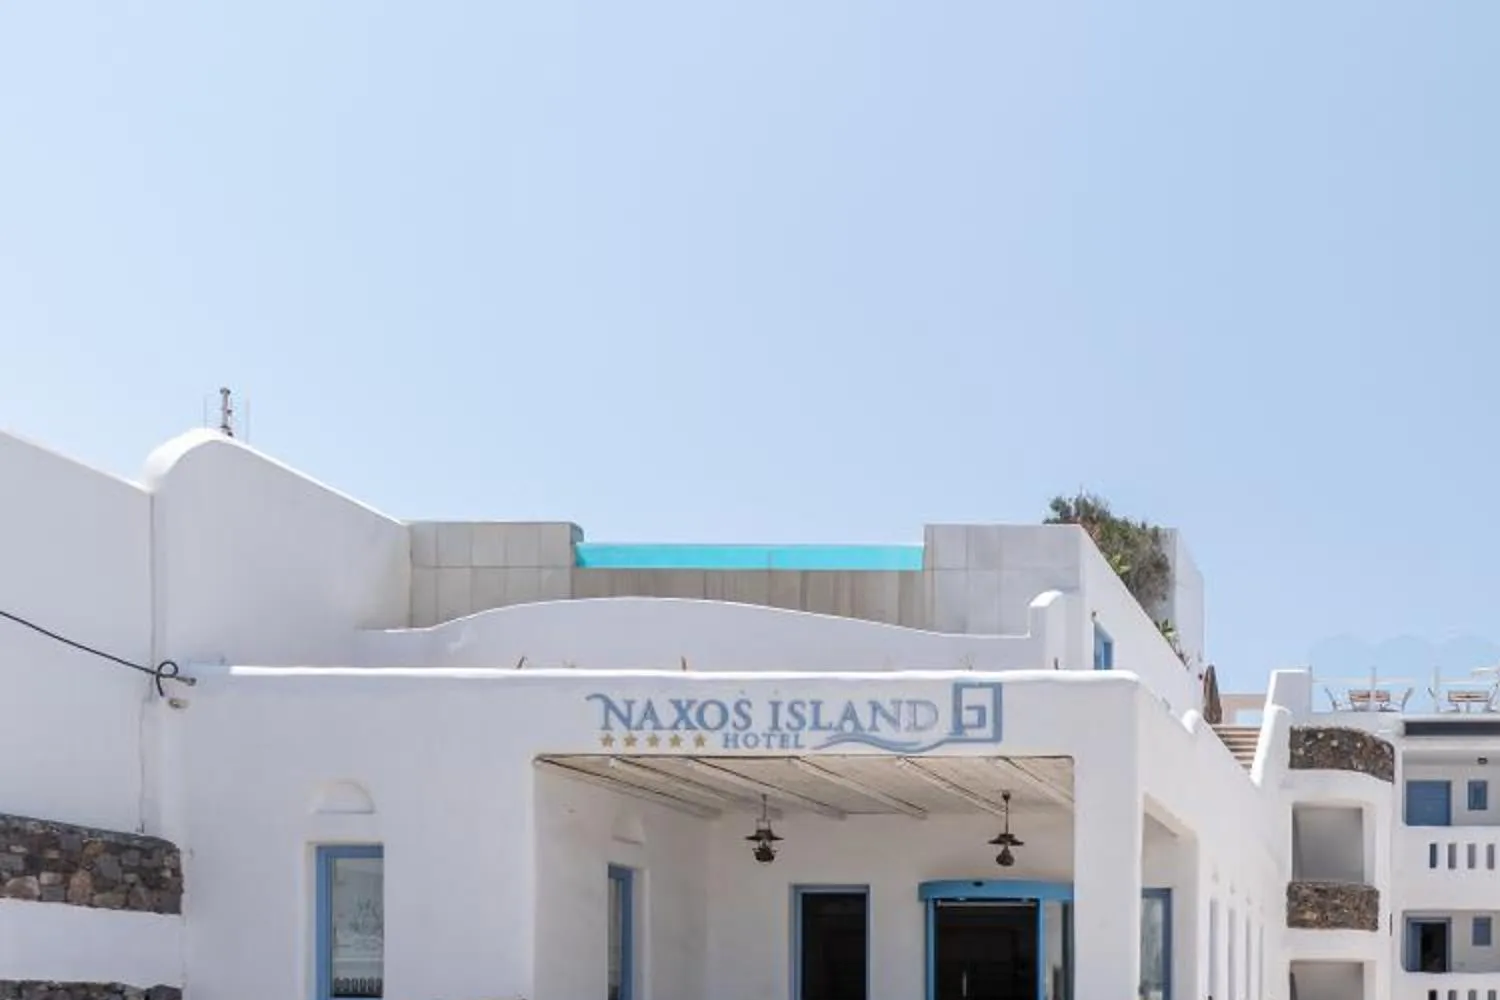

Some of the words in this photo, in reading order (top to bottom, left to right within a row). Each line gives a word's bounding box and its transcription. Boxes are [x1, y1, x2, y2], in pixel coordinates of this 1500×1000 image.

[586, 692, 752, 731] NAXOS
[769, 697, 939, 732] ISLAND
[723, 732, 805, 750] HOTEL
